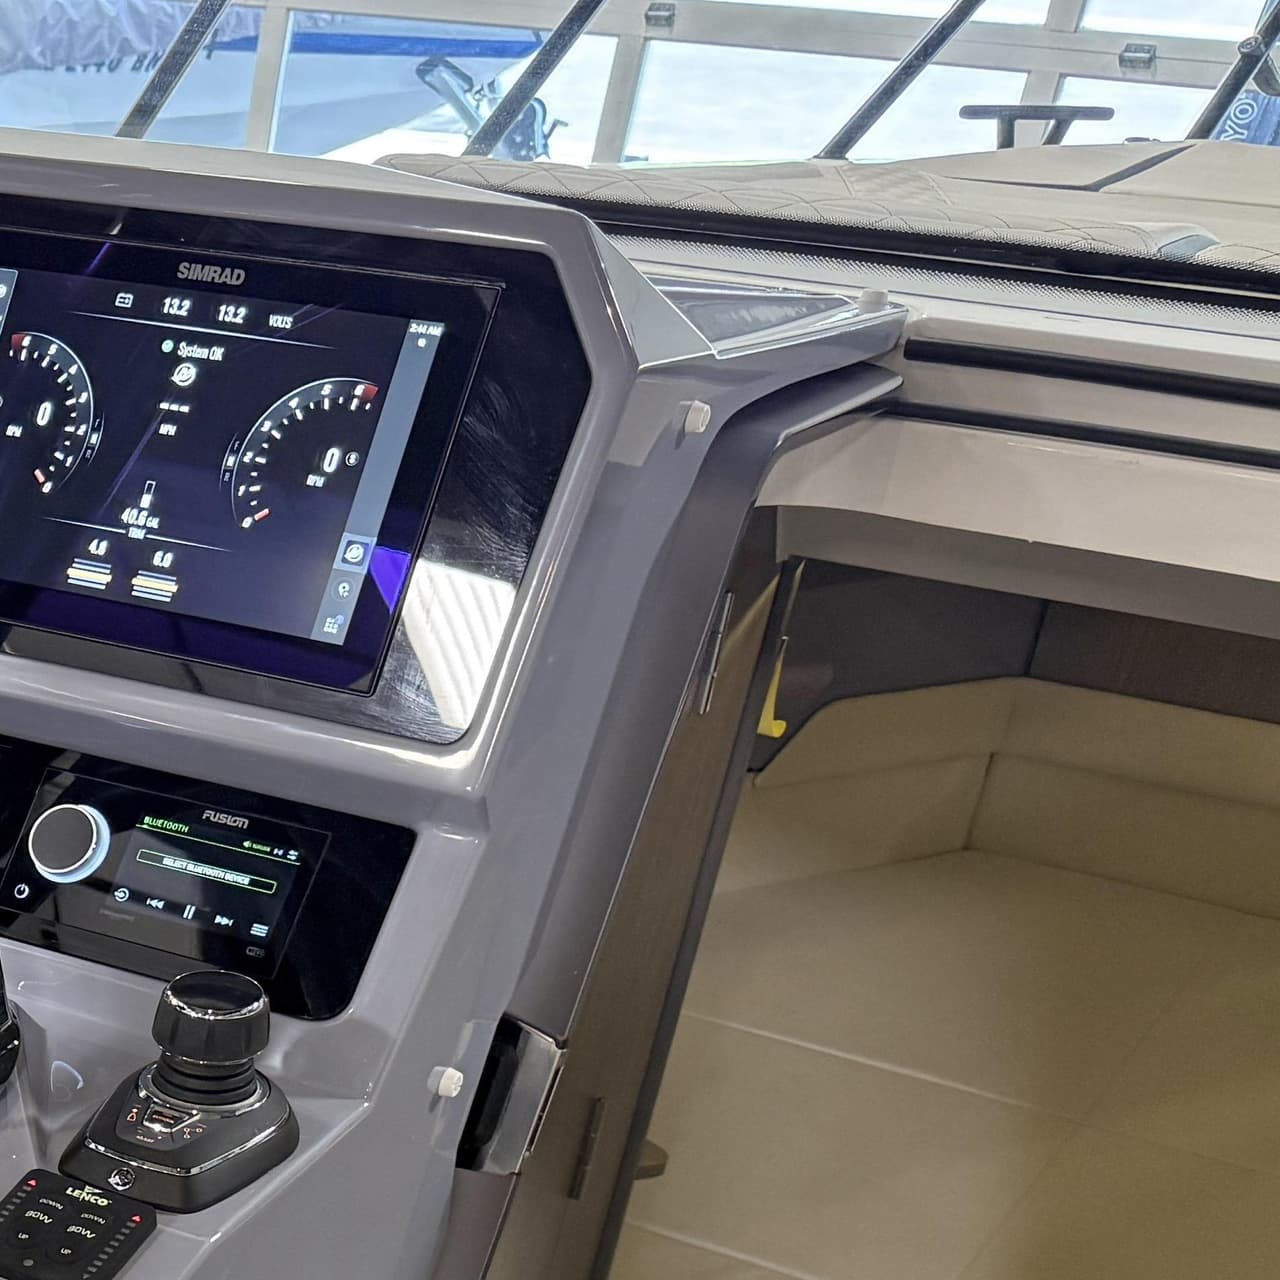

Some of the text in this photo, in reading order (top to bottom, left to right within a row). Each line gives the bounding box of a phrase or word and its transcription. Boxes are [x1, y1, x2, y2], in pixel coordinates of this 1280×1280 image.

[177, 262, 246, 286] SIMRAD
[163, 297, 293, 329] 13.2 13.2 VOLTS
[177, 341, 225, 361] System OK
[36, 401, 52, 426] 0
[323, 448, 340, 473] 0
[121, 507, 148, 527] 40.6
[143, 816, 189, 833] BLUETOOTH
[202, 810, 249, 829] FUSION
[162, 857, 251, 885] SELECT BLUETOOTH DEVICE
[39, 1198, 64, 1210] DOWN
[65, 1186, 109, 1207] LENCO
[24, 1210, 53, 1224] BOW
[81, 1212, 106, 1225] DOWN
[18, 1232, 29, 1240] UP
[67, 1225, 96, 1239] BOW
[60, 1247, 72, 1255] UP
